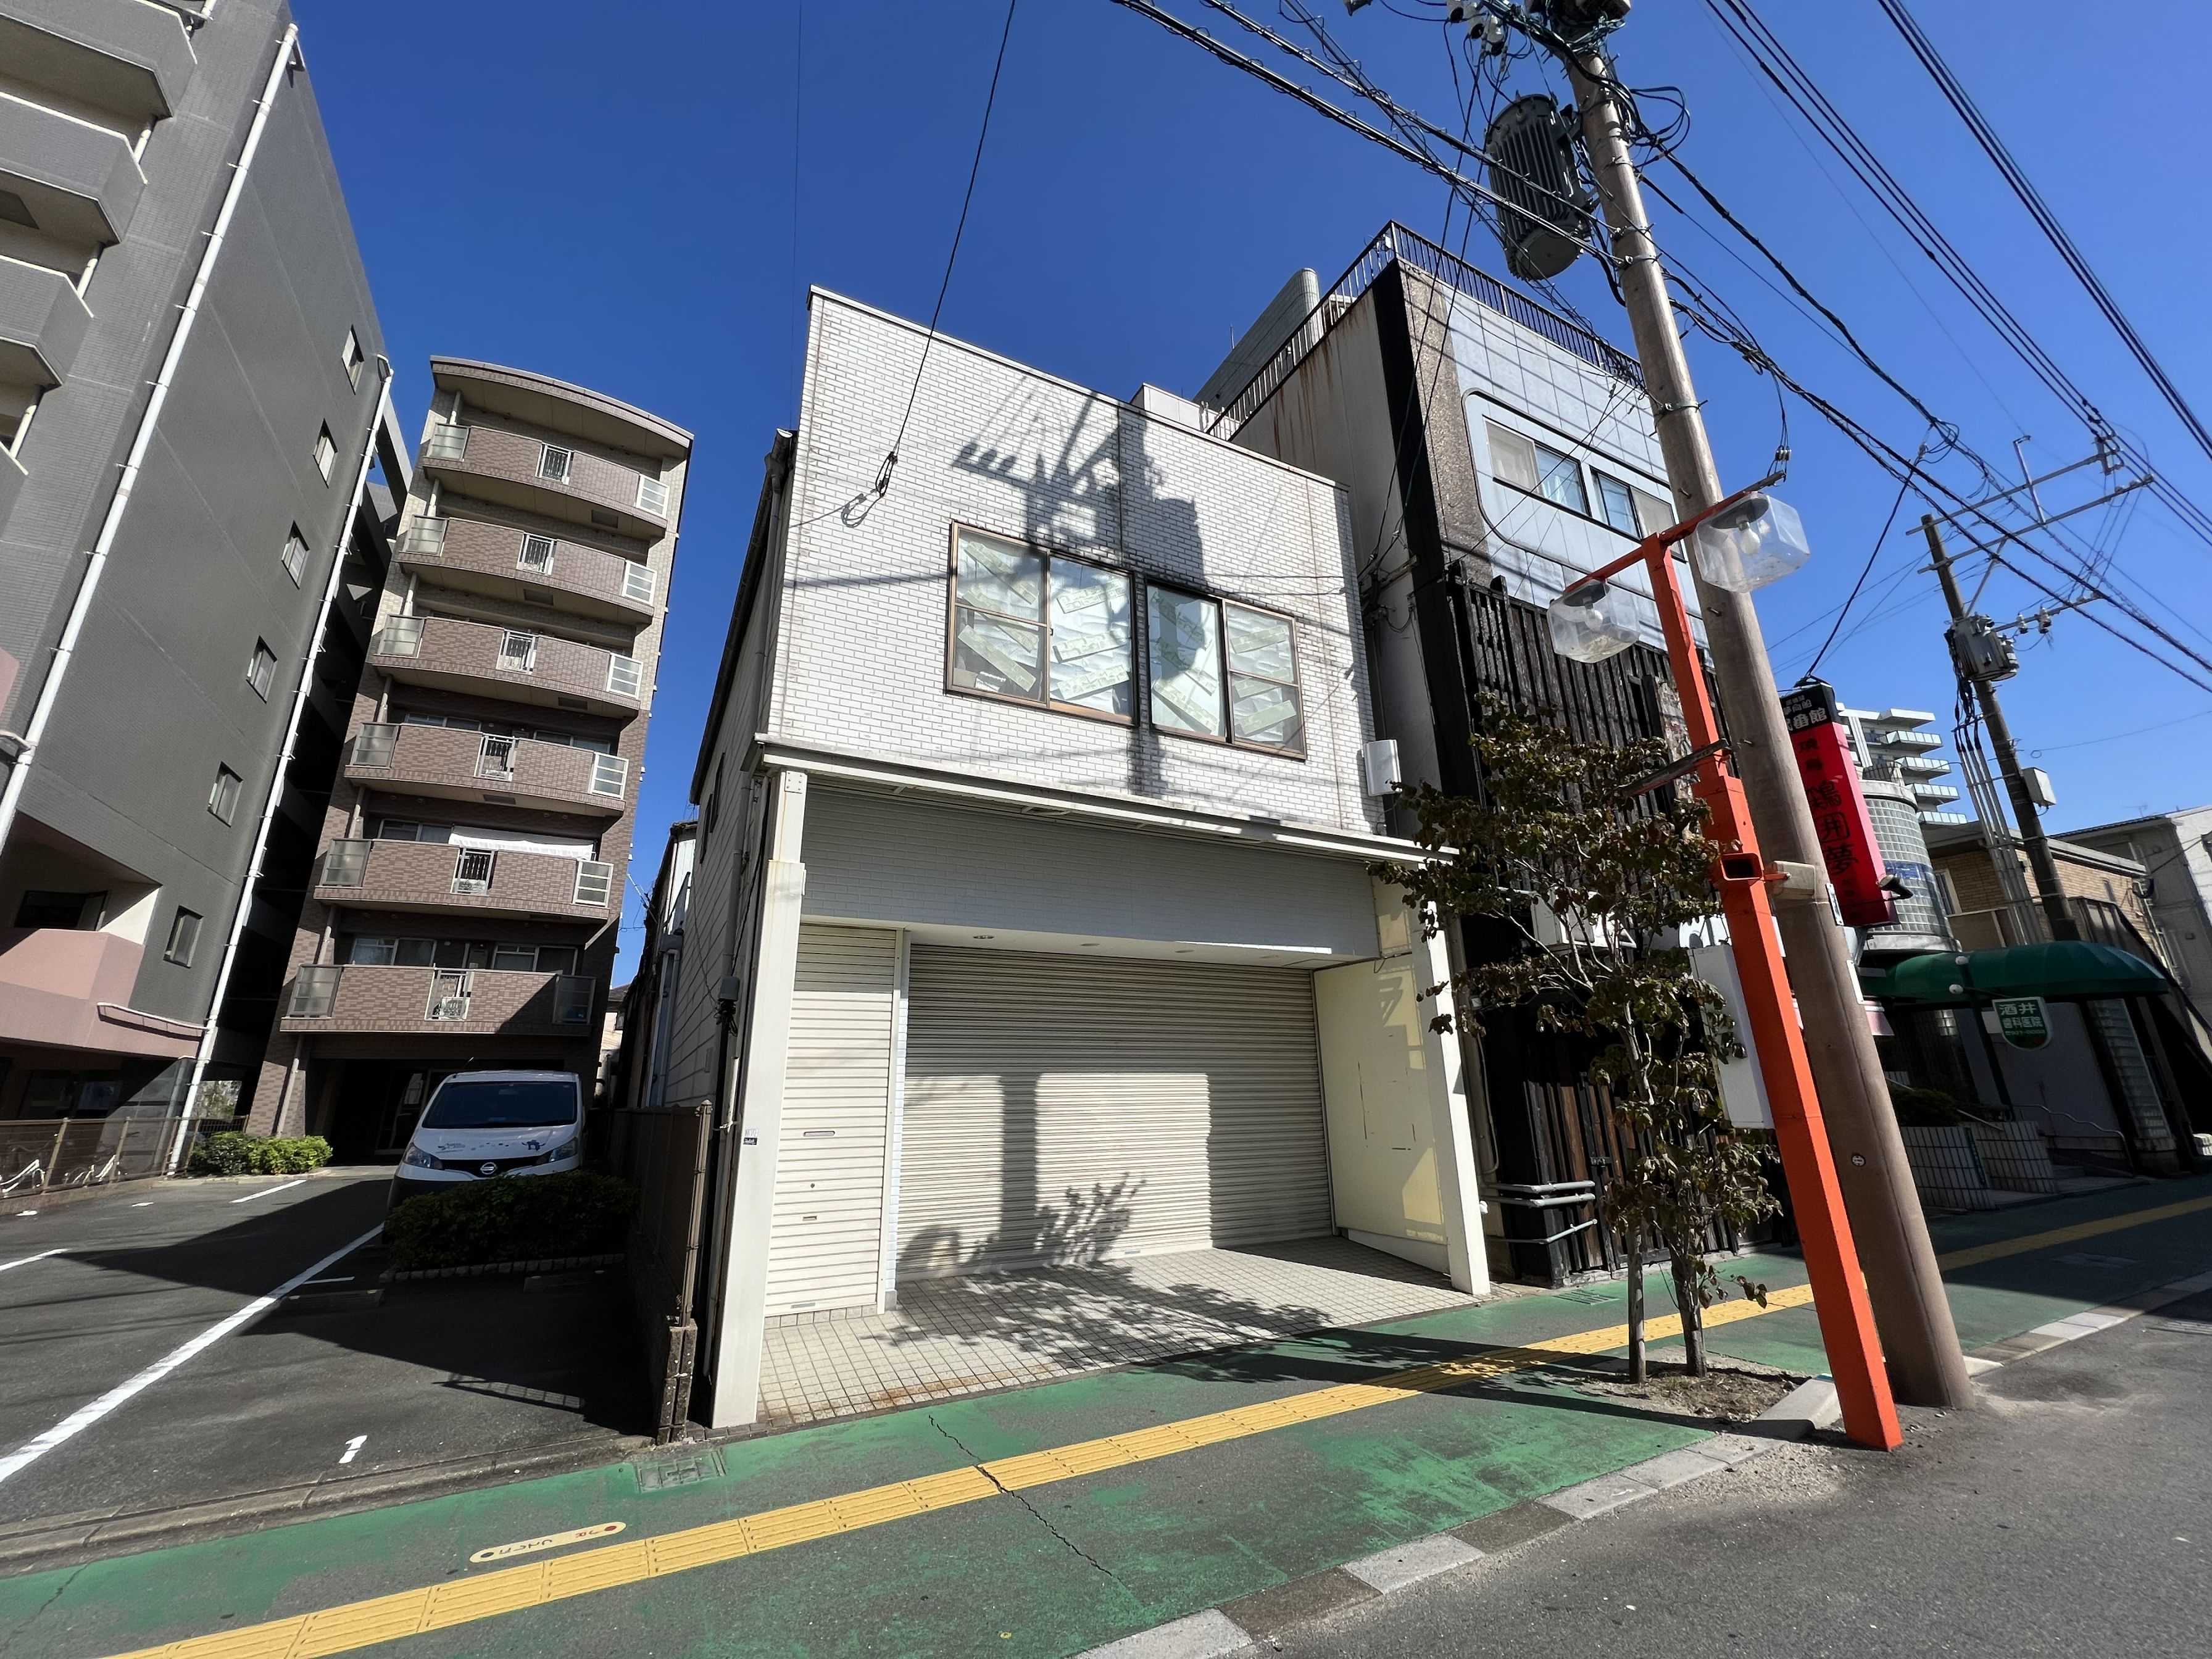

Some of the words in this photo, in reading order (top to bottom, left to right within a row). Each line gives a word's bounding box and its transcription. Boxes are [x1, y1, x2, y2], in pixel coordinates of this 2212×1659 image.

[1999, 1002, 2037, 1015] 酒井
[2002, 1017, 2043, 1028] 歯科医院
